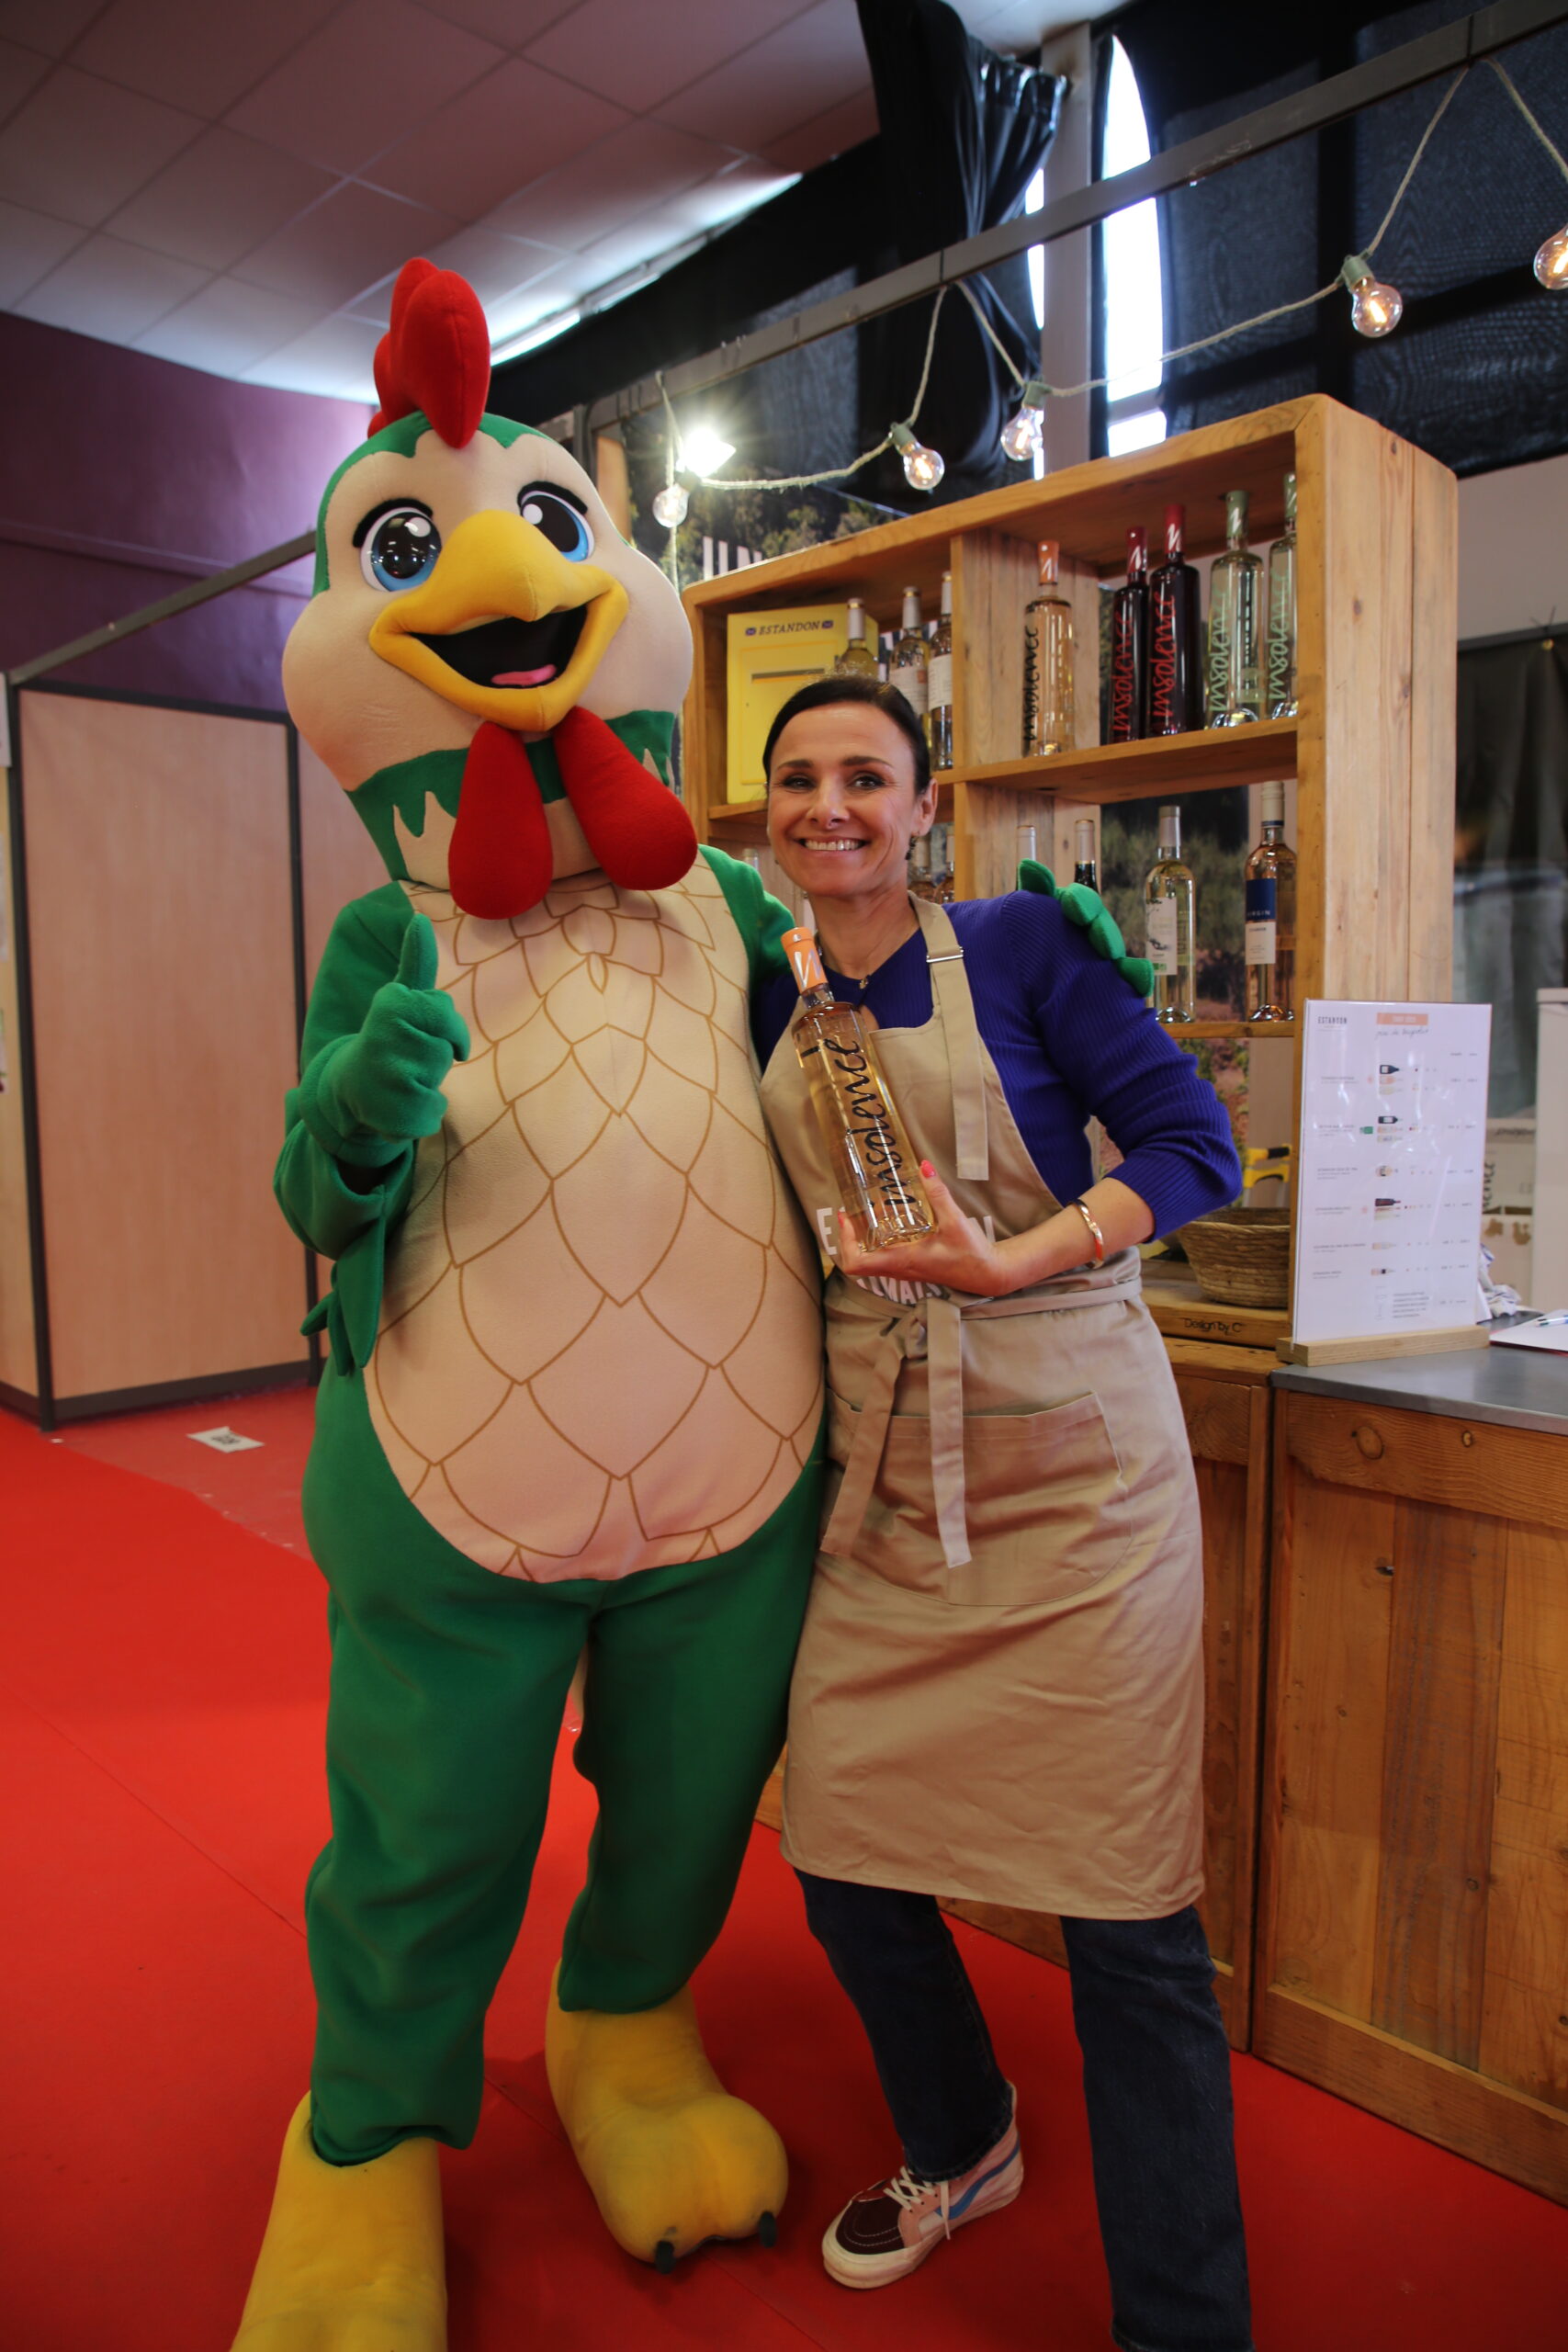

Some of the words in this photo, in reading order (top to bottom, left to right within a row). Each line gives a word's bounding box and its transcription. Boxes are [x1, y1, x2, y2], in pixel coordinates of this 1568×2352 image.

[759, 620, 820, 636] ESTANDON
[1184, 1318, 1216, 1332] Design
[1218, 1322, 1231, 1336] by
